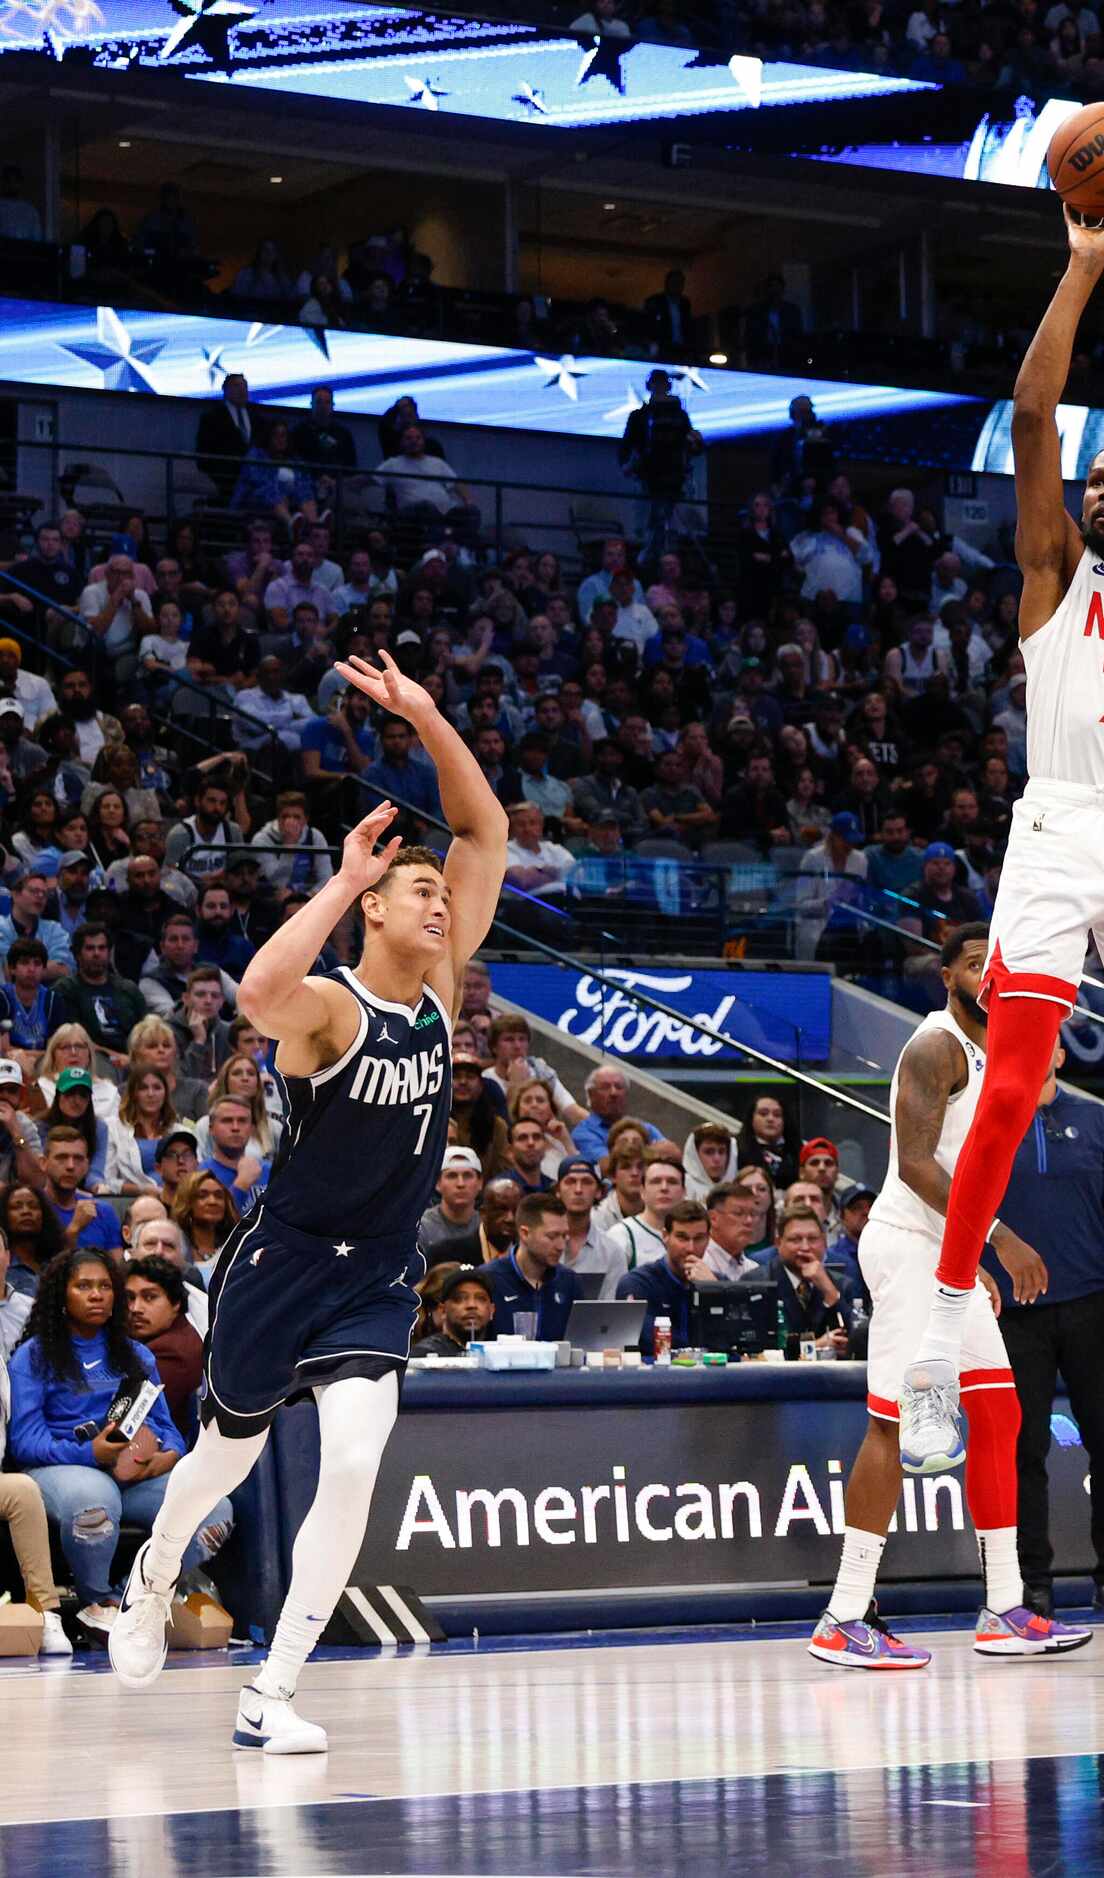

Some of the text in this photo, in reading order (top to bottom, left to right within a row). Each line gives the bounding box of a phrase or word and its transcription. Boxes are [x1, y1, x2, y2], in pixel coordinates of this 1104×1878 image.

[868, 740, 898, 764] ETS
[557, 968, 736, 1056] Ford
[348, 1043, 444, 1106] MAVS
[413, 1103, 433, 1156] 7
[395, 1465, 762, 1551] American
